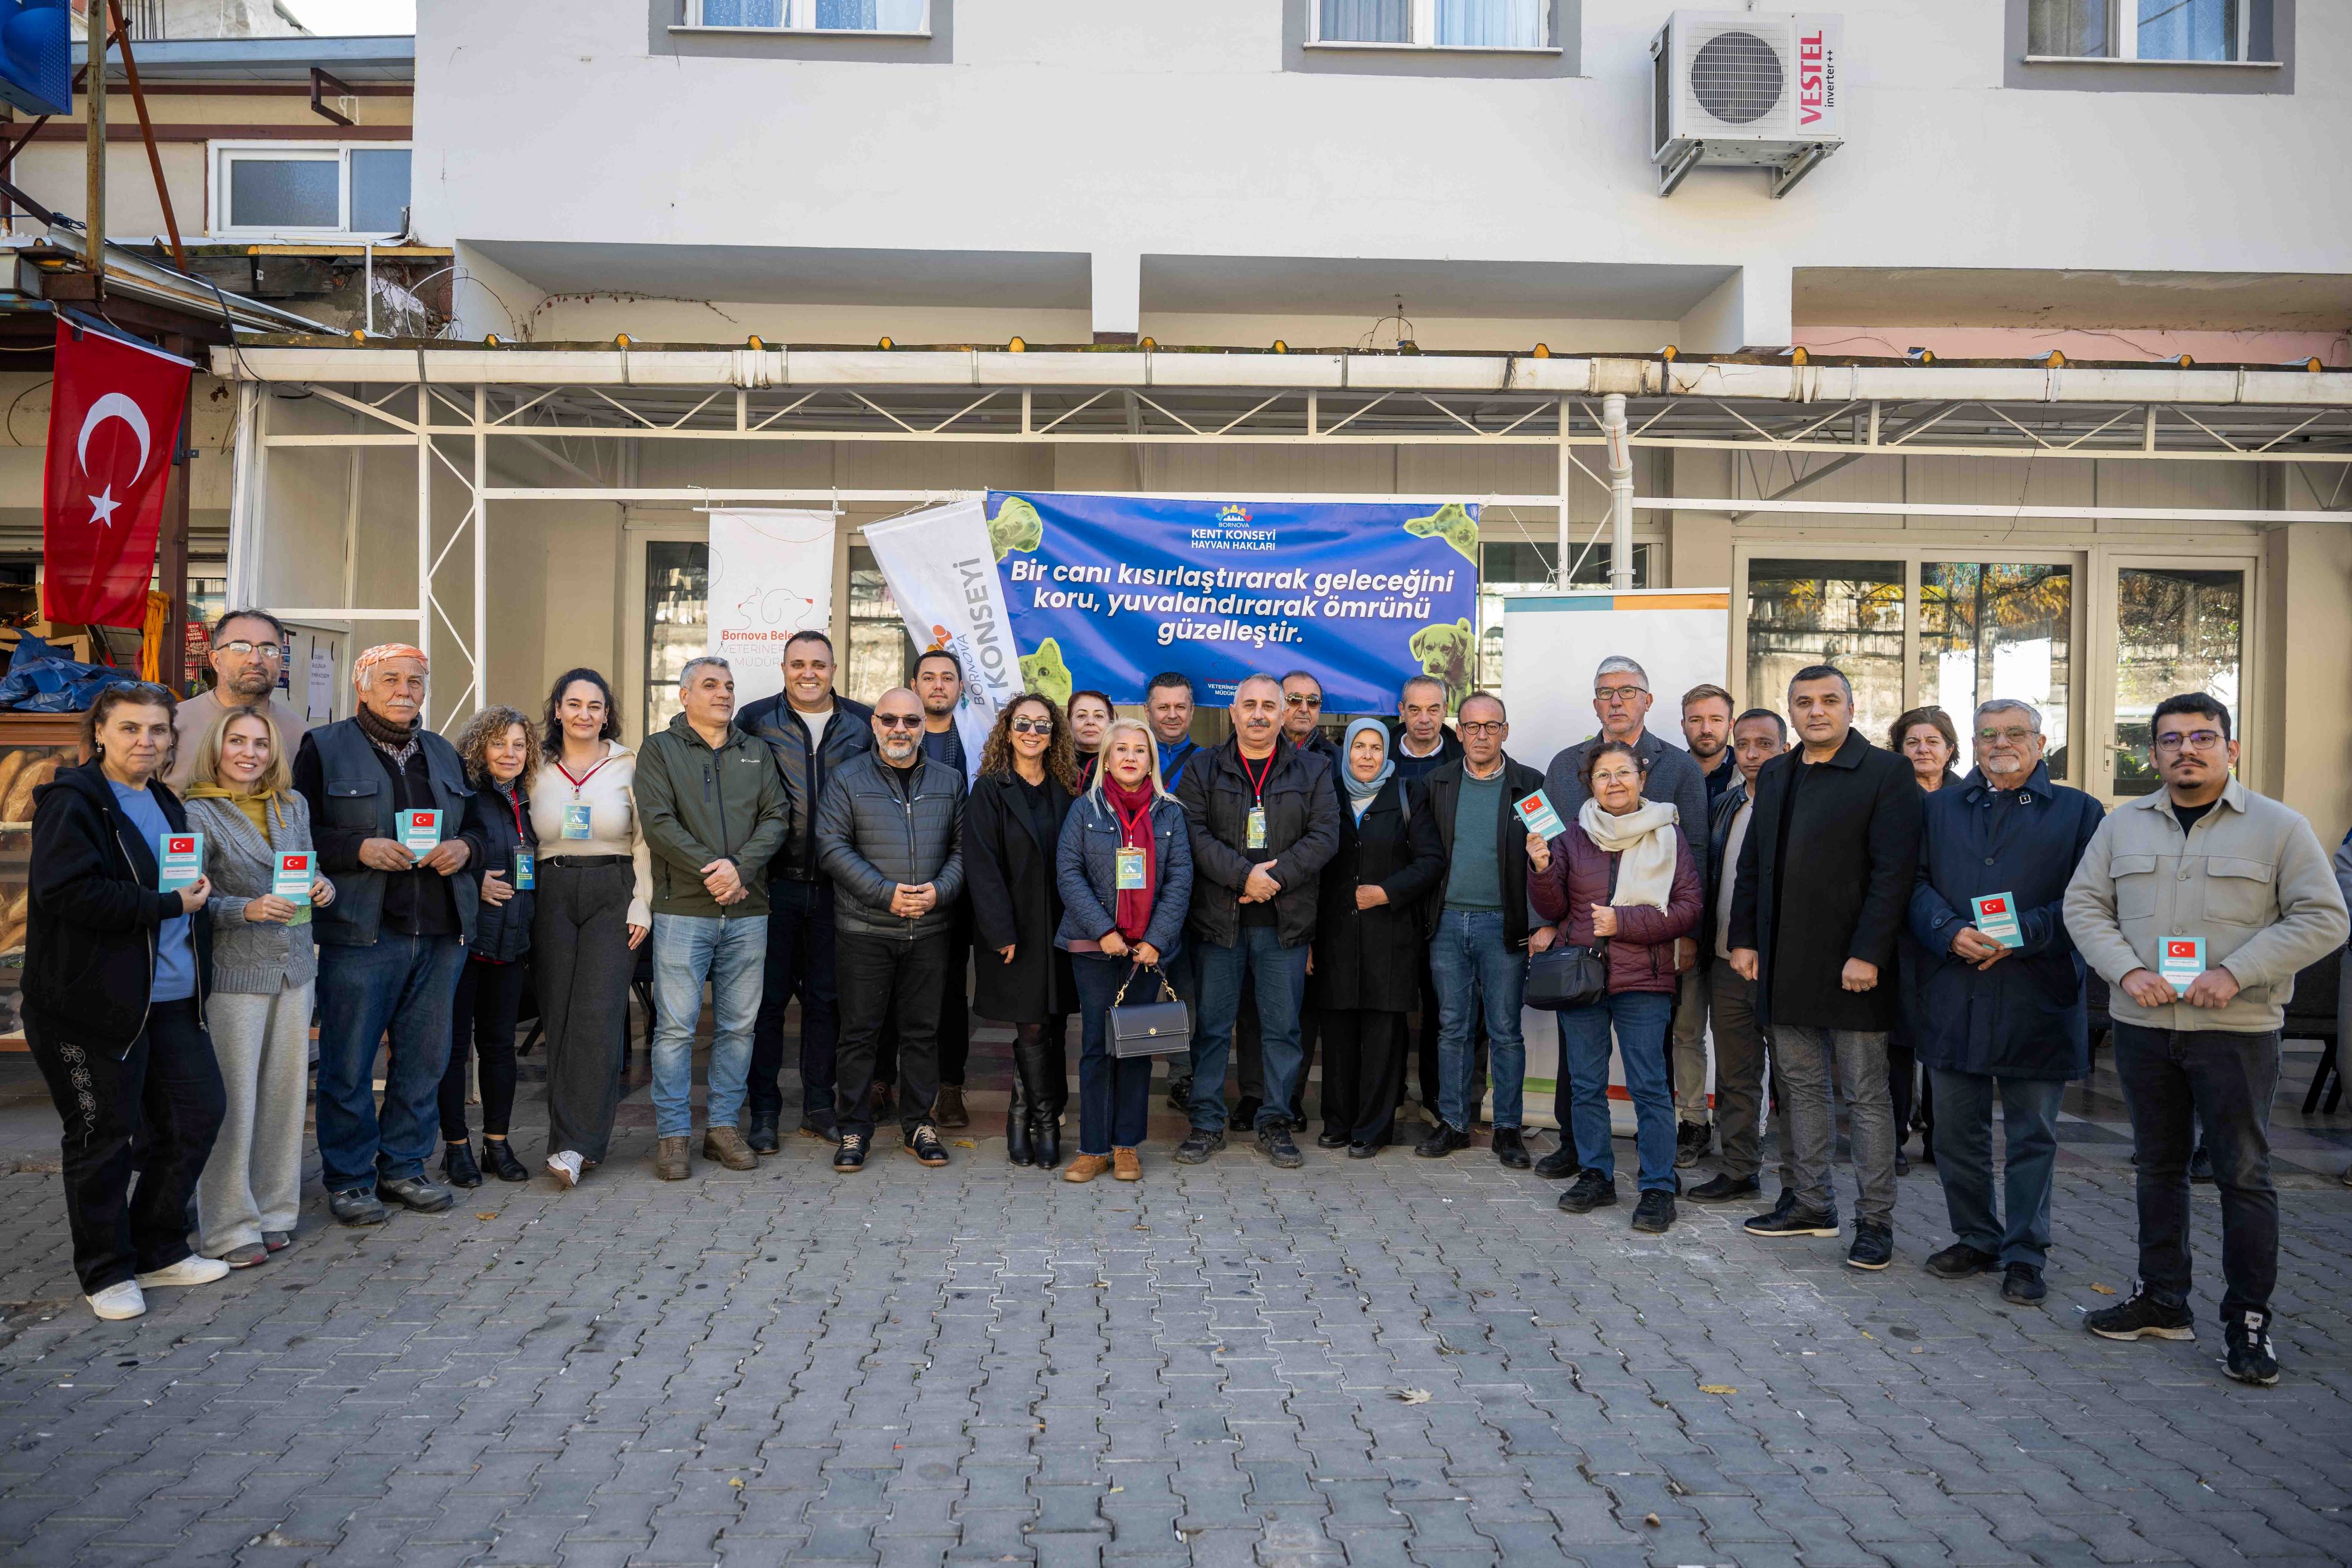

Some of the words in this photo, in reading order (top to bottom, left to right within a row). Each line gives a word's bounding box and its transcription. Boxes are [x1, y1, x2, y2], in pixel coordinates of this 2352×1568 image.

[1800, 30, 1822, 125] VESTEL
[1191, 540, 1230, 549] HAYVAN
[1232, 541, 1275, 551] HAKLARI
[1192, 528, 1223, 539] KENT
[1226, 529, 1276, 541] KONSEYİ
[1010, 558, 1048, 581] Bir
[1052, 565, 1112, 583] canı
[1117, 563, 1310, 594] kısırlaştırarak
[1313, 569, 1455, 599] geleceğini
[1033, 586, 1100, 612] koru,
[1107, 592, 1319, 617] yuvalandırarak
[1323, 595, 1431, 619] ömrünü
[722, 630, 768, 640] Bornova
[952, 558, 1009, 689] KONSEYİ
[1157, 617, 1303, 649] güzelleştir.
[956, 633, 985, 705] BORNOVA
